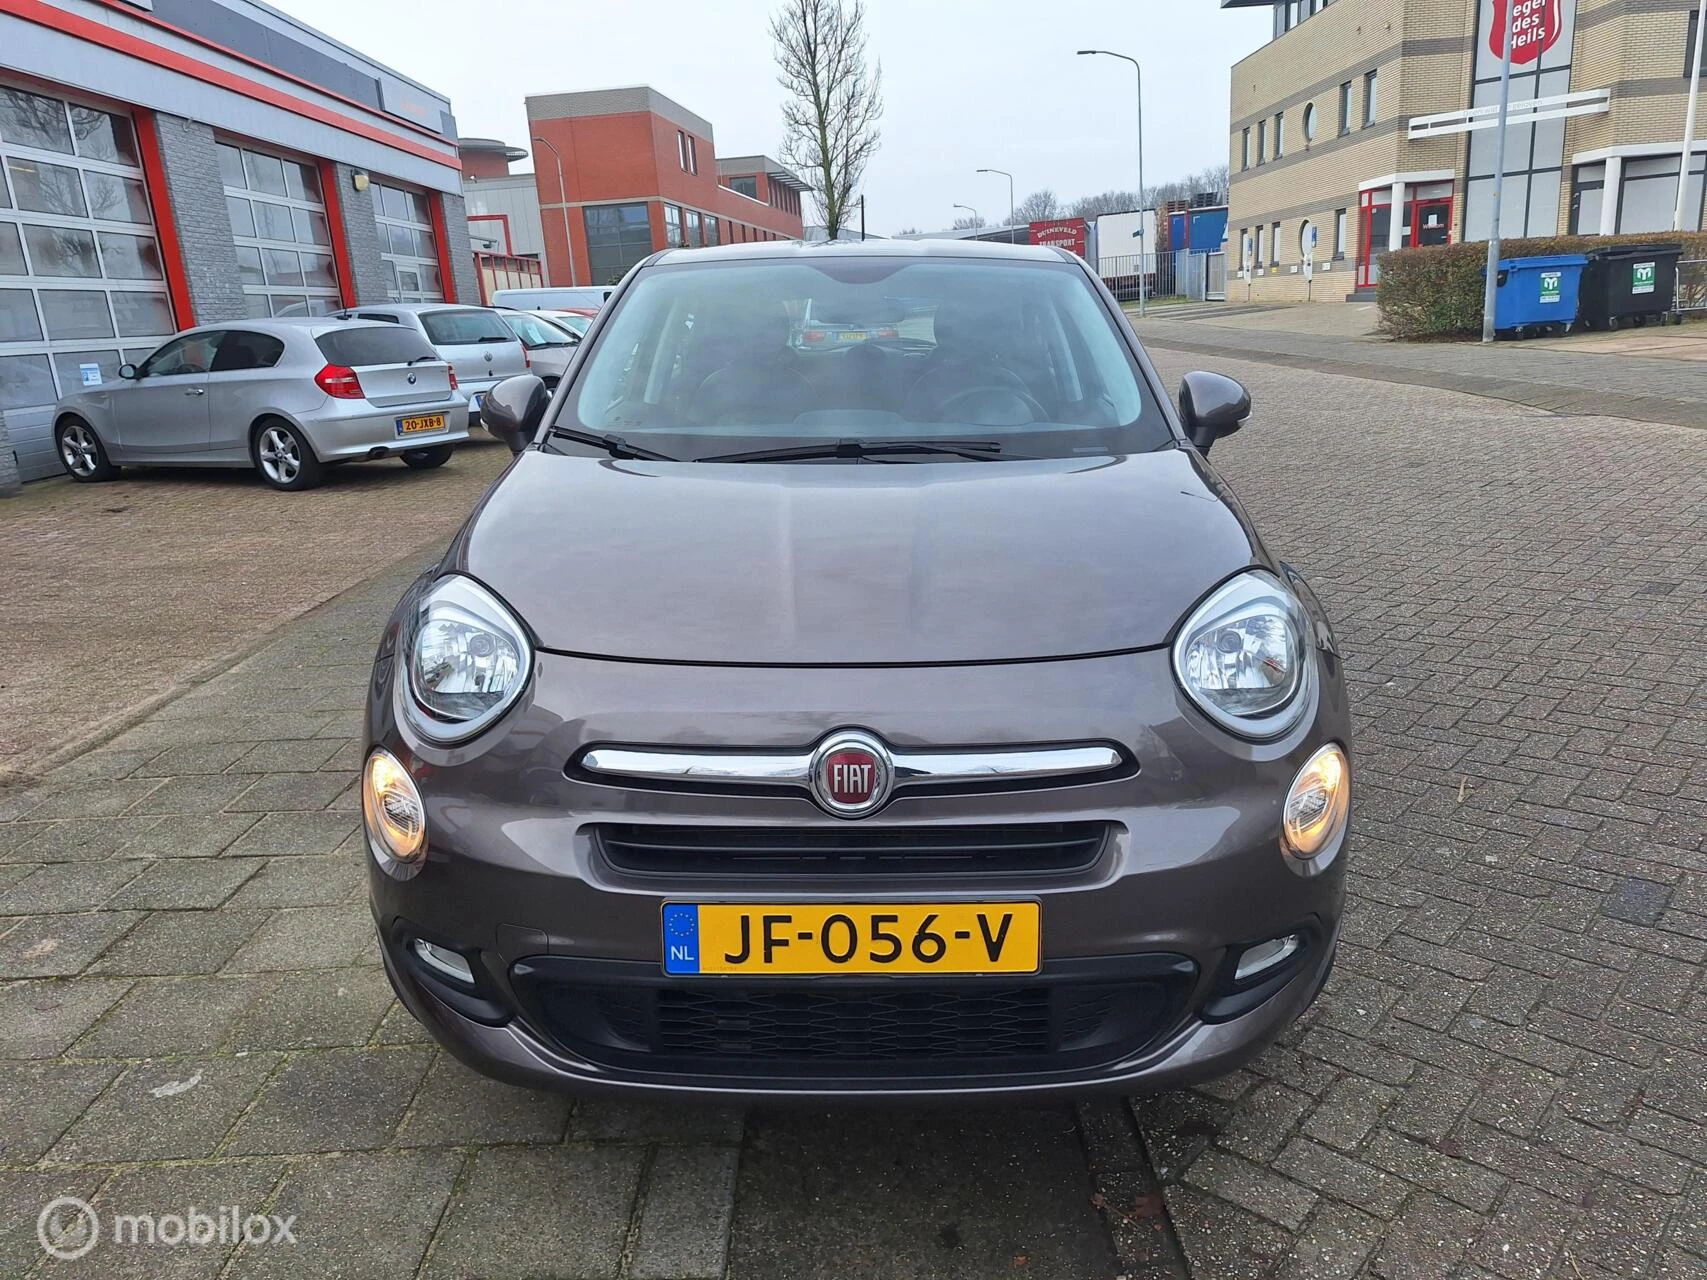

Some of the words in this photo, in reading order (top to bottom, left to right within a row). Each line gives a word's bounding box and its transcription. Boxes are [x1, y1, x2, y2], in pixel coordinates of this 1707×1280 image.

[1513, 0, 1546, 17] ege
[1512, 13, 1540, 33] des
[1037, 226, 1077, 238] DUINEVELD
[1039, 239, 1076, 247] TRANSPORT
[405, 416, 442, 430] 20-JXB-8
[833, 764, 872, 794] FIAT
[724, 913, 1014, 964] JF-056-V
[670, 945, 695, 961] NL
